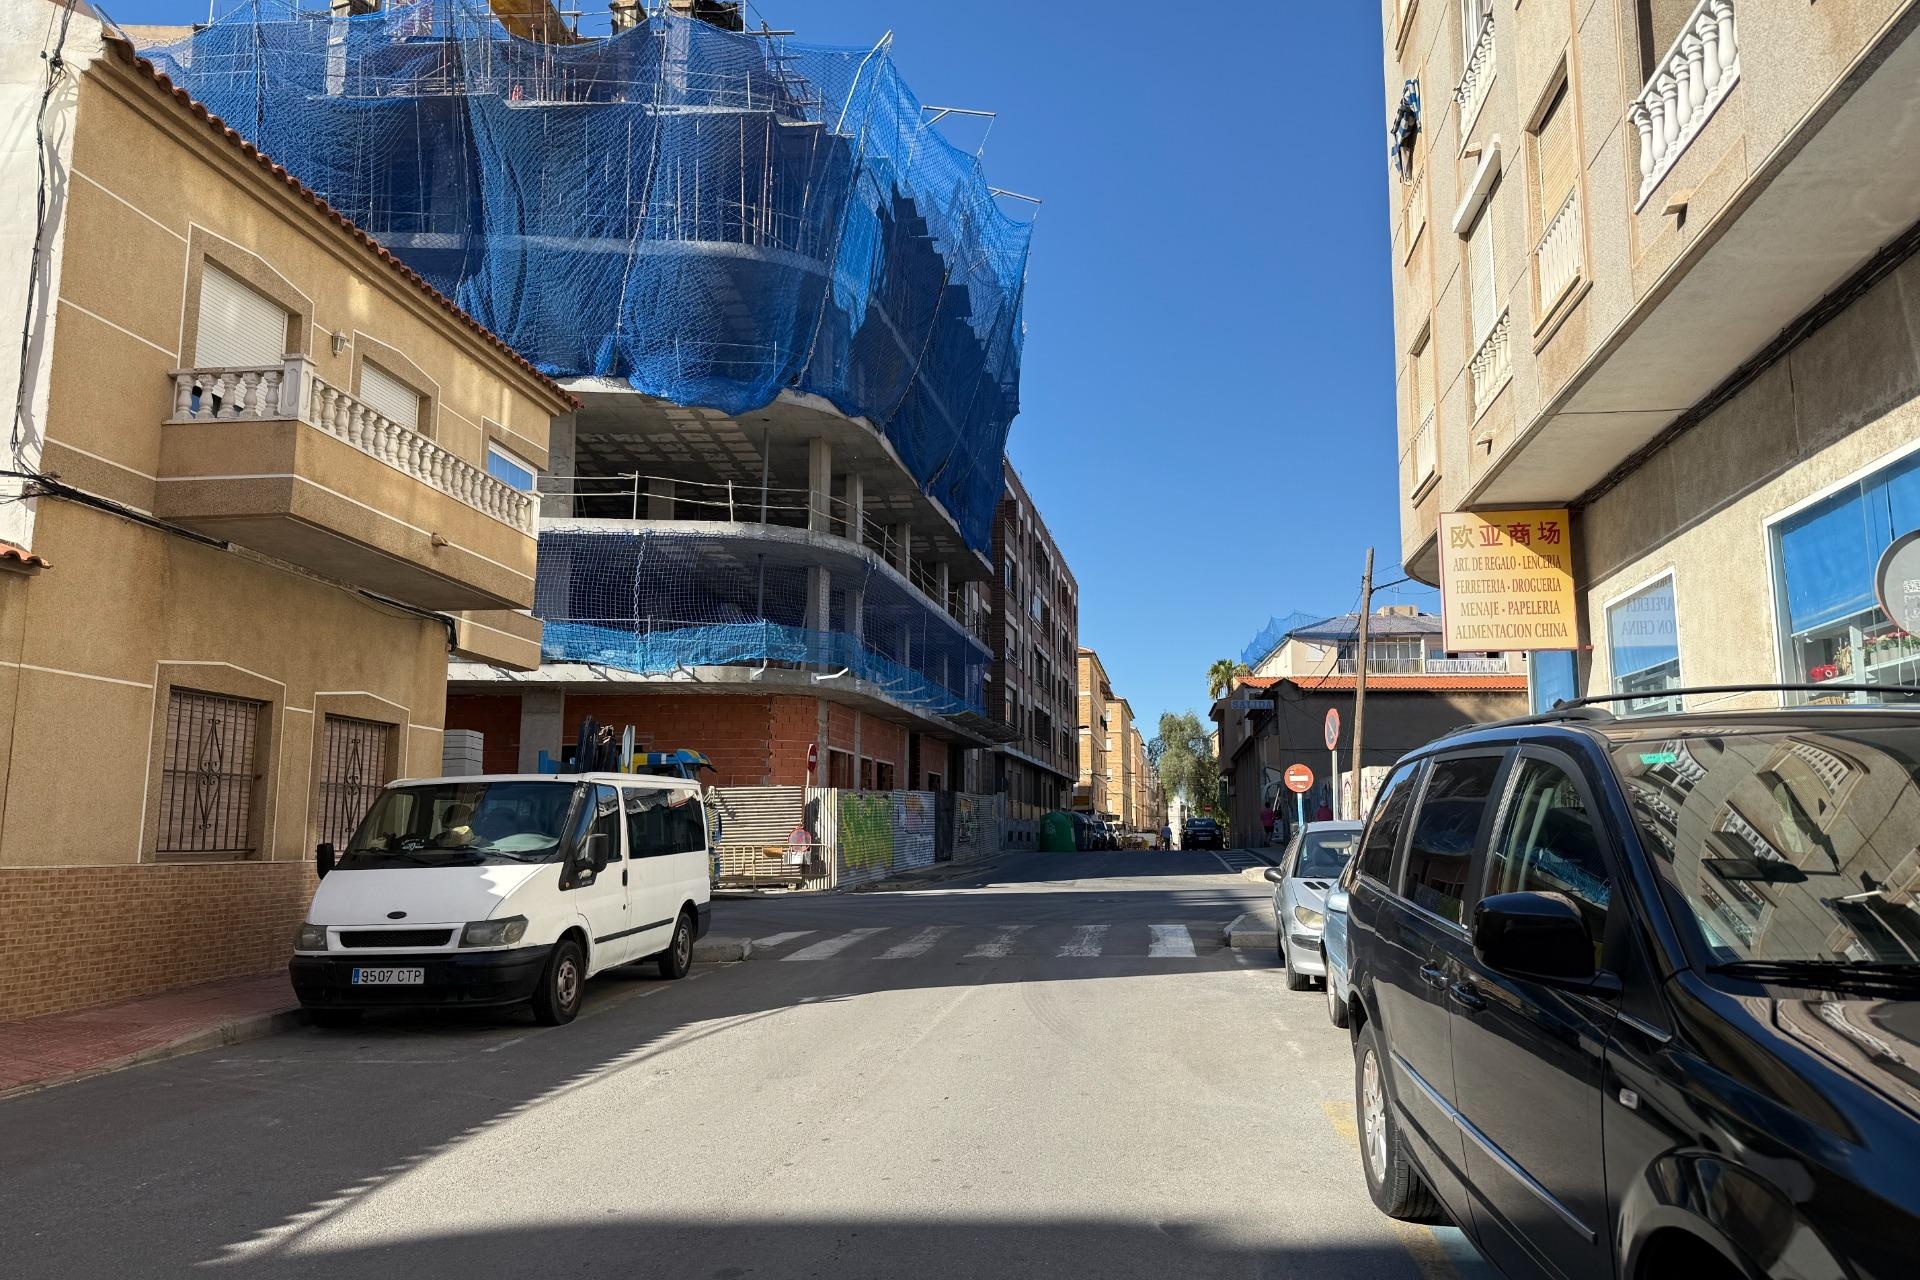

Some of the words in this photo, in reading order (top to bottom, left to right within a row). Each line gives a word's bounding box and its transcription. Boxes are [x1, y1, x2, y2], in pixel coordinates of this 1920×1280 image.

[1450, 521, 1561, 549] 欧亚商场
[1472, 556, 1483, 571] DE
[1485, 555, 1516, 571] REGALO
[1523, 554, 1561, 569] LENCERIA
[1456, 579, 1505, 594] FERRETERIA
[1512, 577, 1561, 592] DROGUERIA
[1461, 601, 1499, 619] MENAJE
[1508, 600, 1560, 615] PAPELERIA
[1456, 623, 1532, 639] ALIMENTACION
[1535, 622, 1568, 638] CHINA
[361, 970, 394, 983] 9507
[397, 969, 422, 983] CTP
